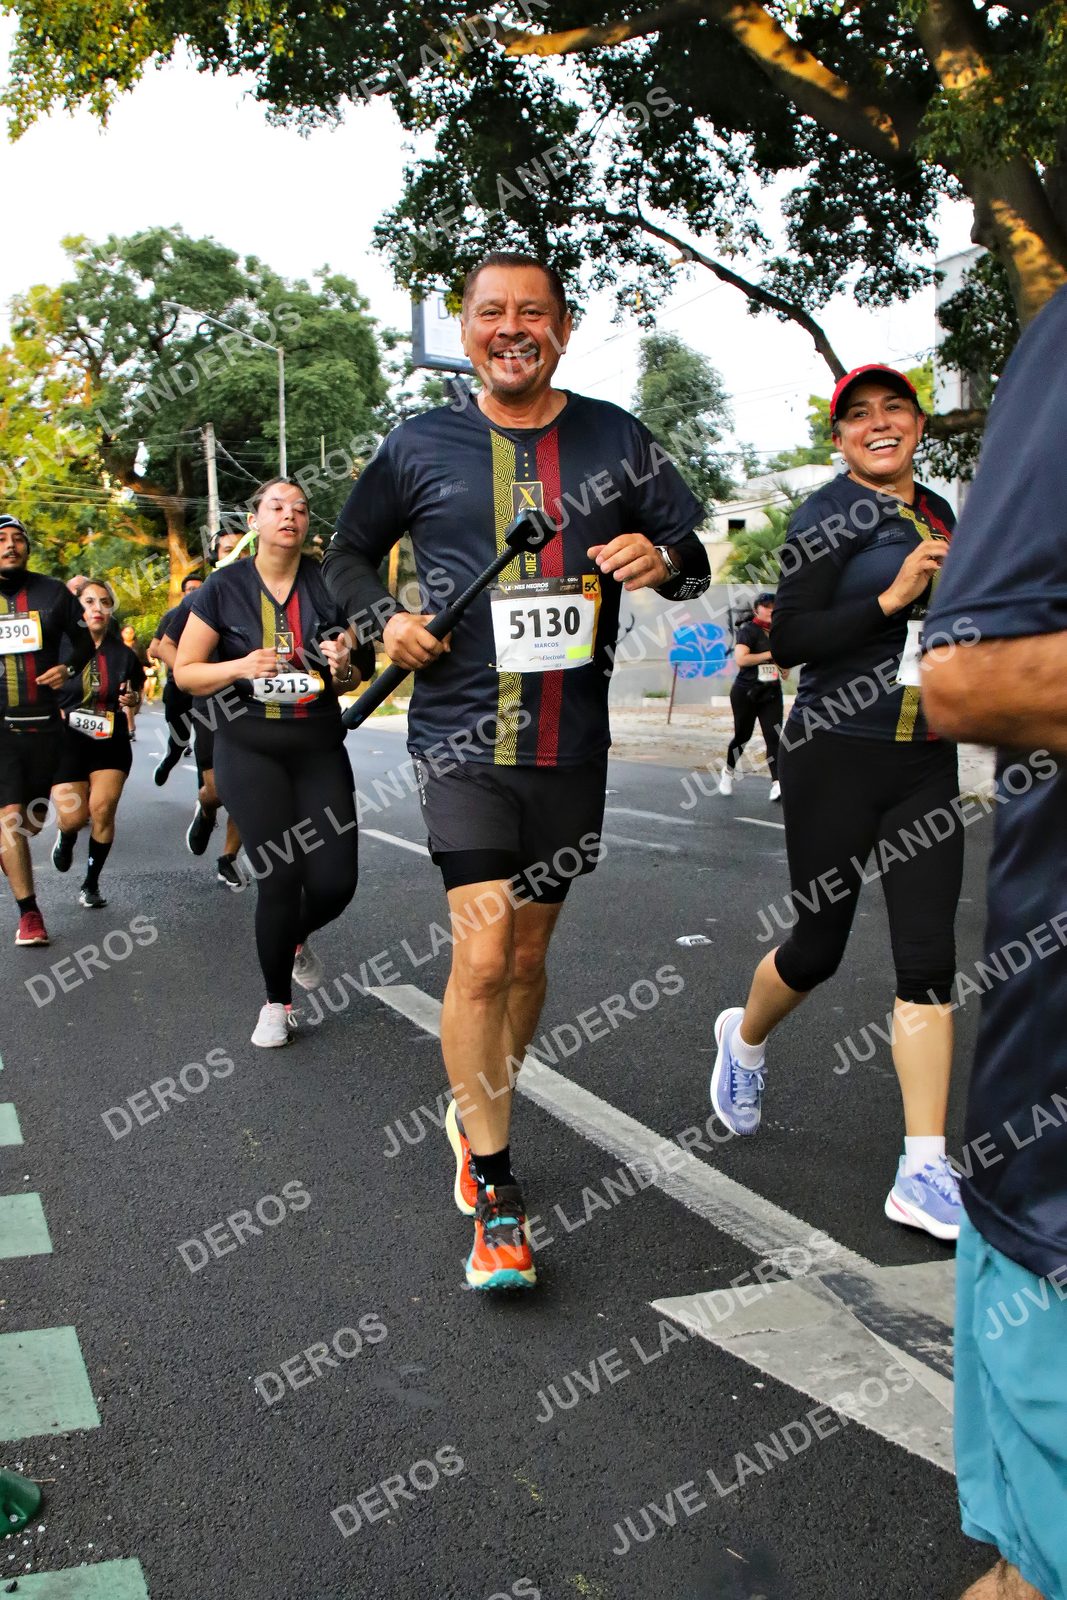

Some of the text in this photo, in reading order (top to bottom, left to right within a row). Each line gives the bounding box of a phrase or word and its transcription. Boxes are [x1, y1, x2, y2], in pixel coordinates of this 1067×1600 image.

[510, 605, 580, 640] 5130
[264, 679, 309, 694] 5215
[75, 717, 104, 732] 3894
